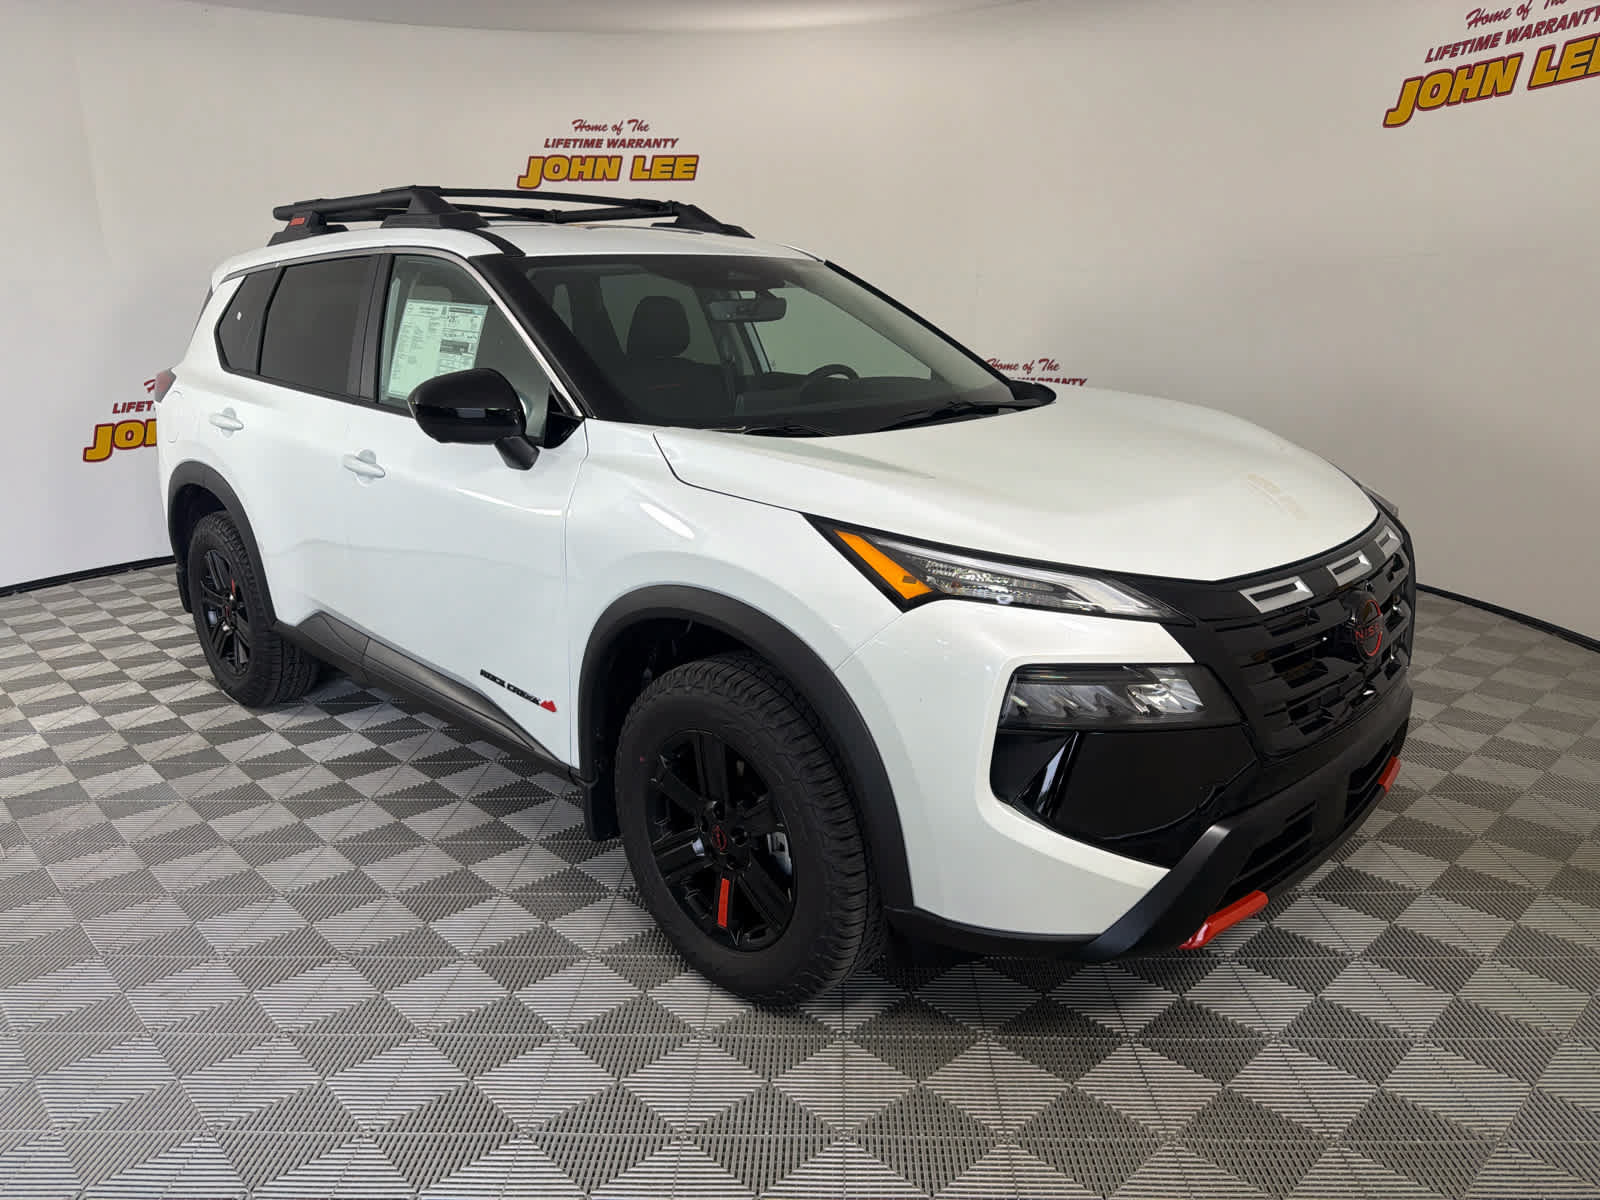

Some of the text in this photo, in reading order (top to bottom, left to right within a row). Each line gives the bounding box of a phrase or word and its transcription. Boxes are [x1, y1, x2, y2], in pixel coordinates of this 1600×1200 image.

[1465, 7, 1512, 29] Home
[1516, 0, 1533, 21] of
[1424, 32, 1503, 63] LIFETIME
[1383, 32, 1600, 128] JOHN LE
[571, 119, 649, 135] Home of The
[544, 138, 679, 148] LIFETIME WARRANTY
[516, 155, 699, 189] JOHN LEE
[1022, 360, 1035, 375] of
[1038, 358, 1060, 371] The
[1017, 376, 1088, 386] RRANTY
[112, 400, 155, 414] LIFET
